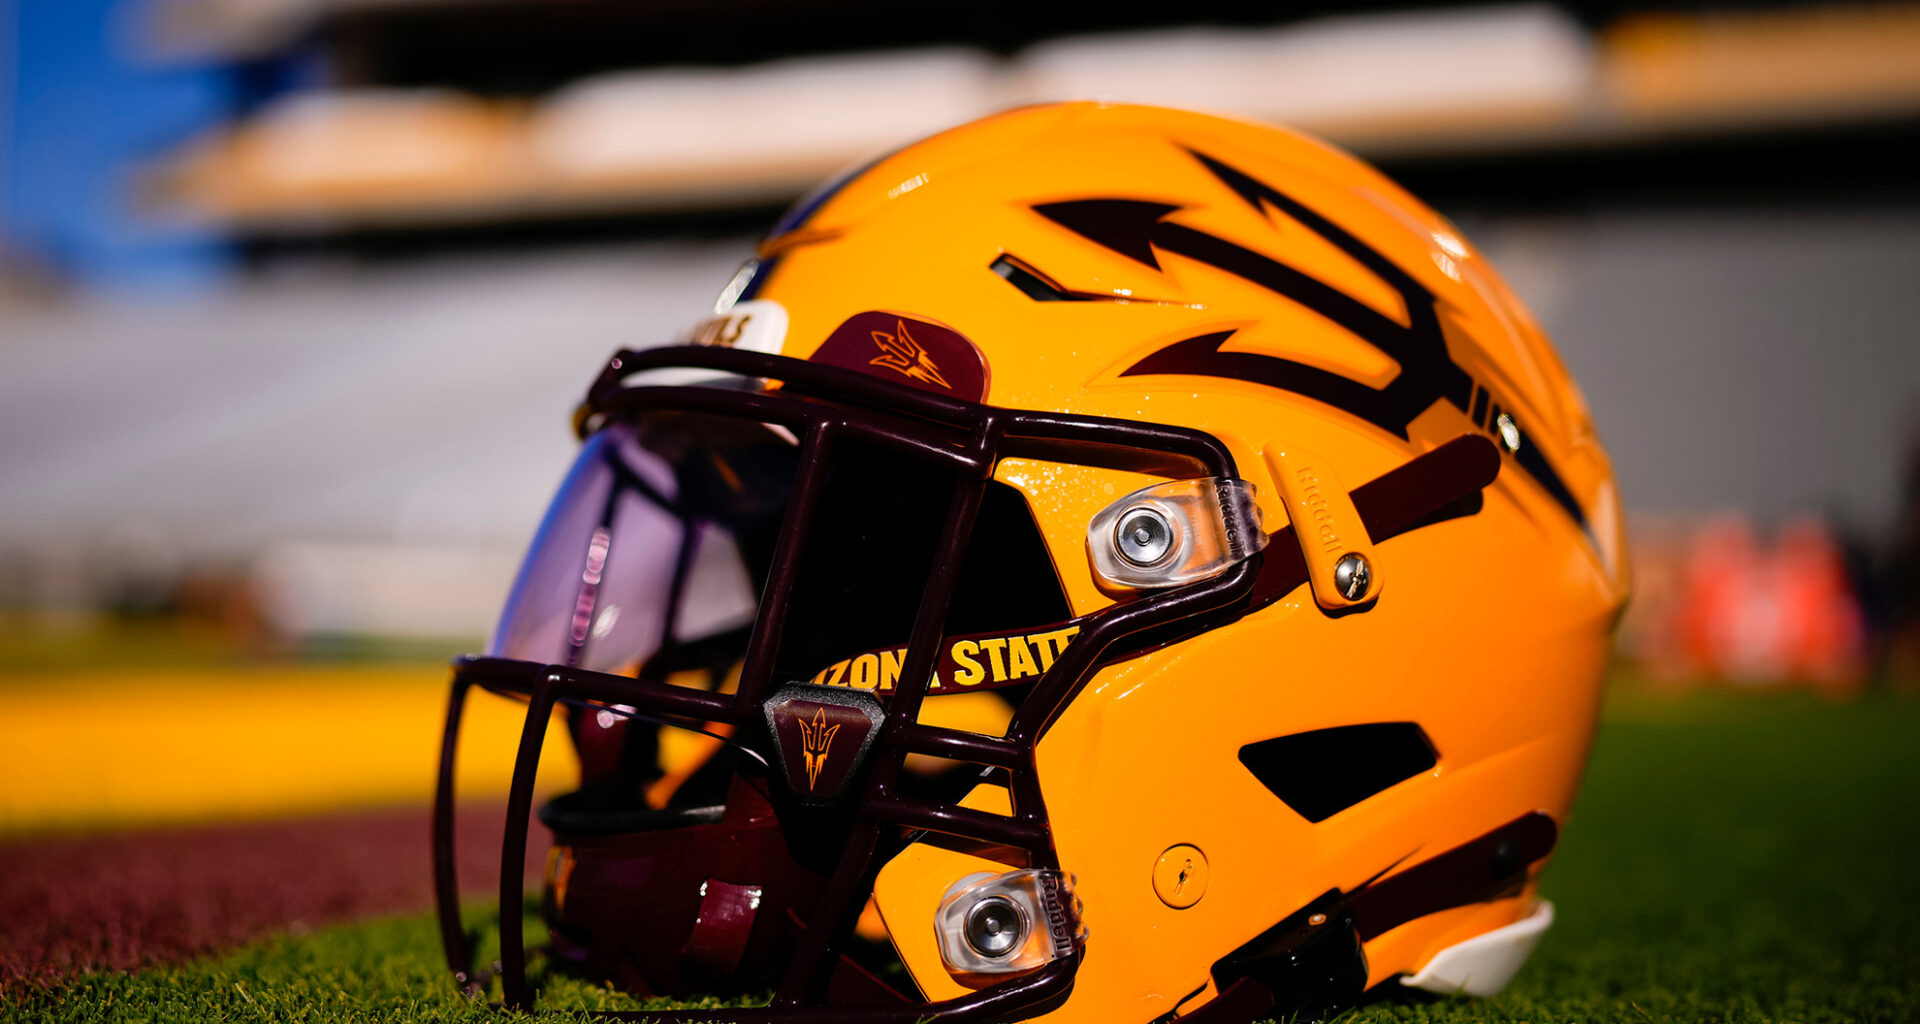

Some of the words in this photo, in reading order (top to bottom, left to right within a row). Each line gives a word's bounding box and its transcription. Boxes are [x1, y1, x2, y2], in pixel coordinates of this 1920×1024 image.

[1216, 481, 1246, 556] Riddell
[1297, 466, 1343, 553] Riddell
[1041, 876, 1072, 951] Riddell
